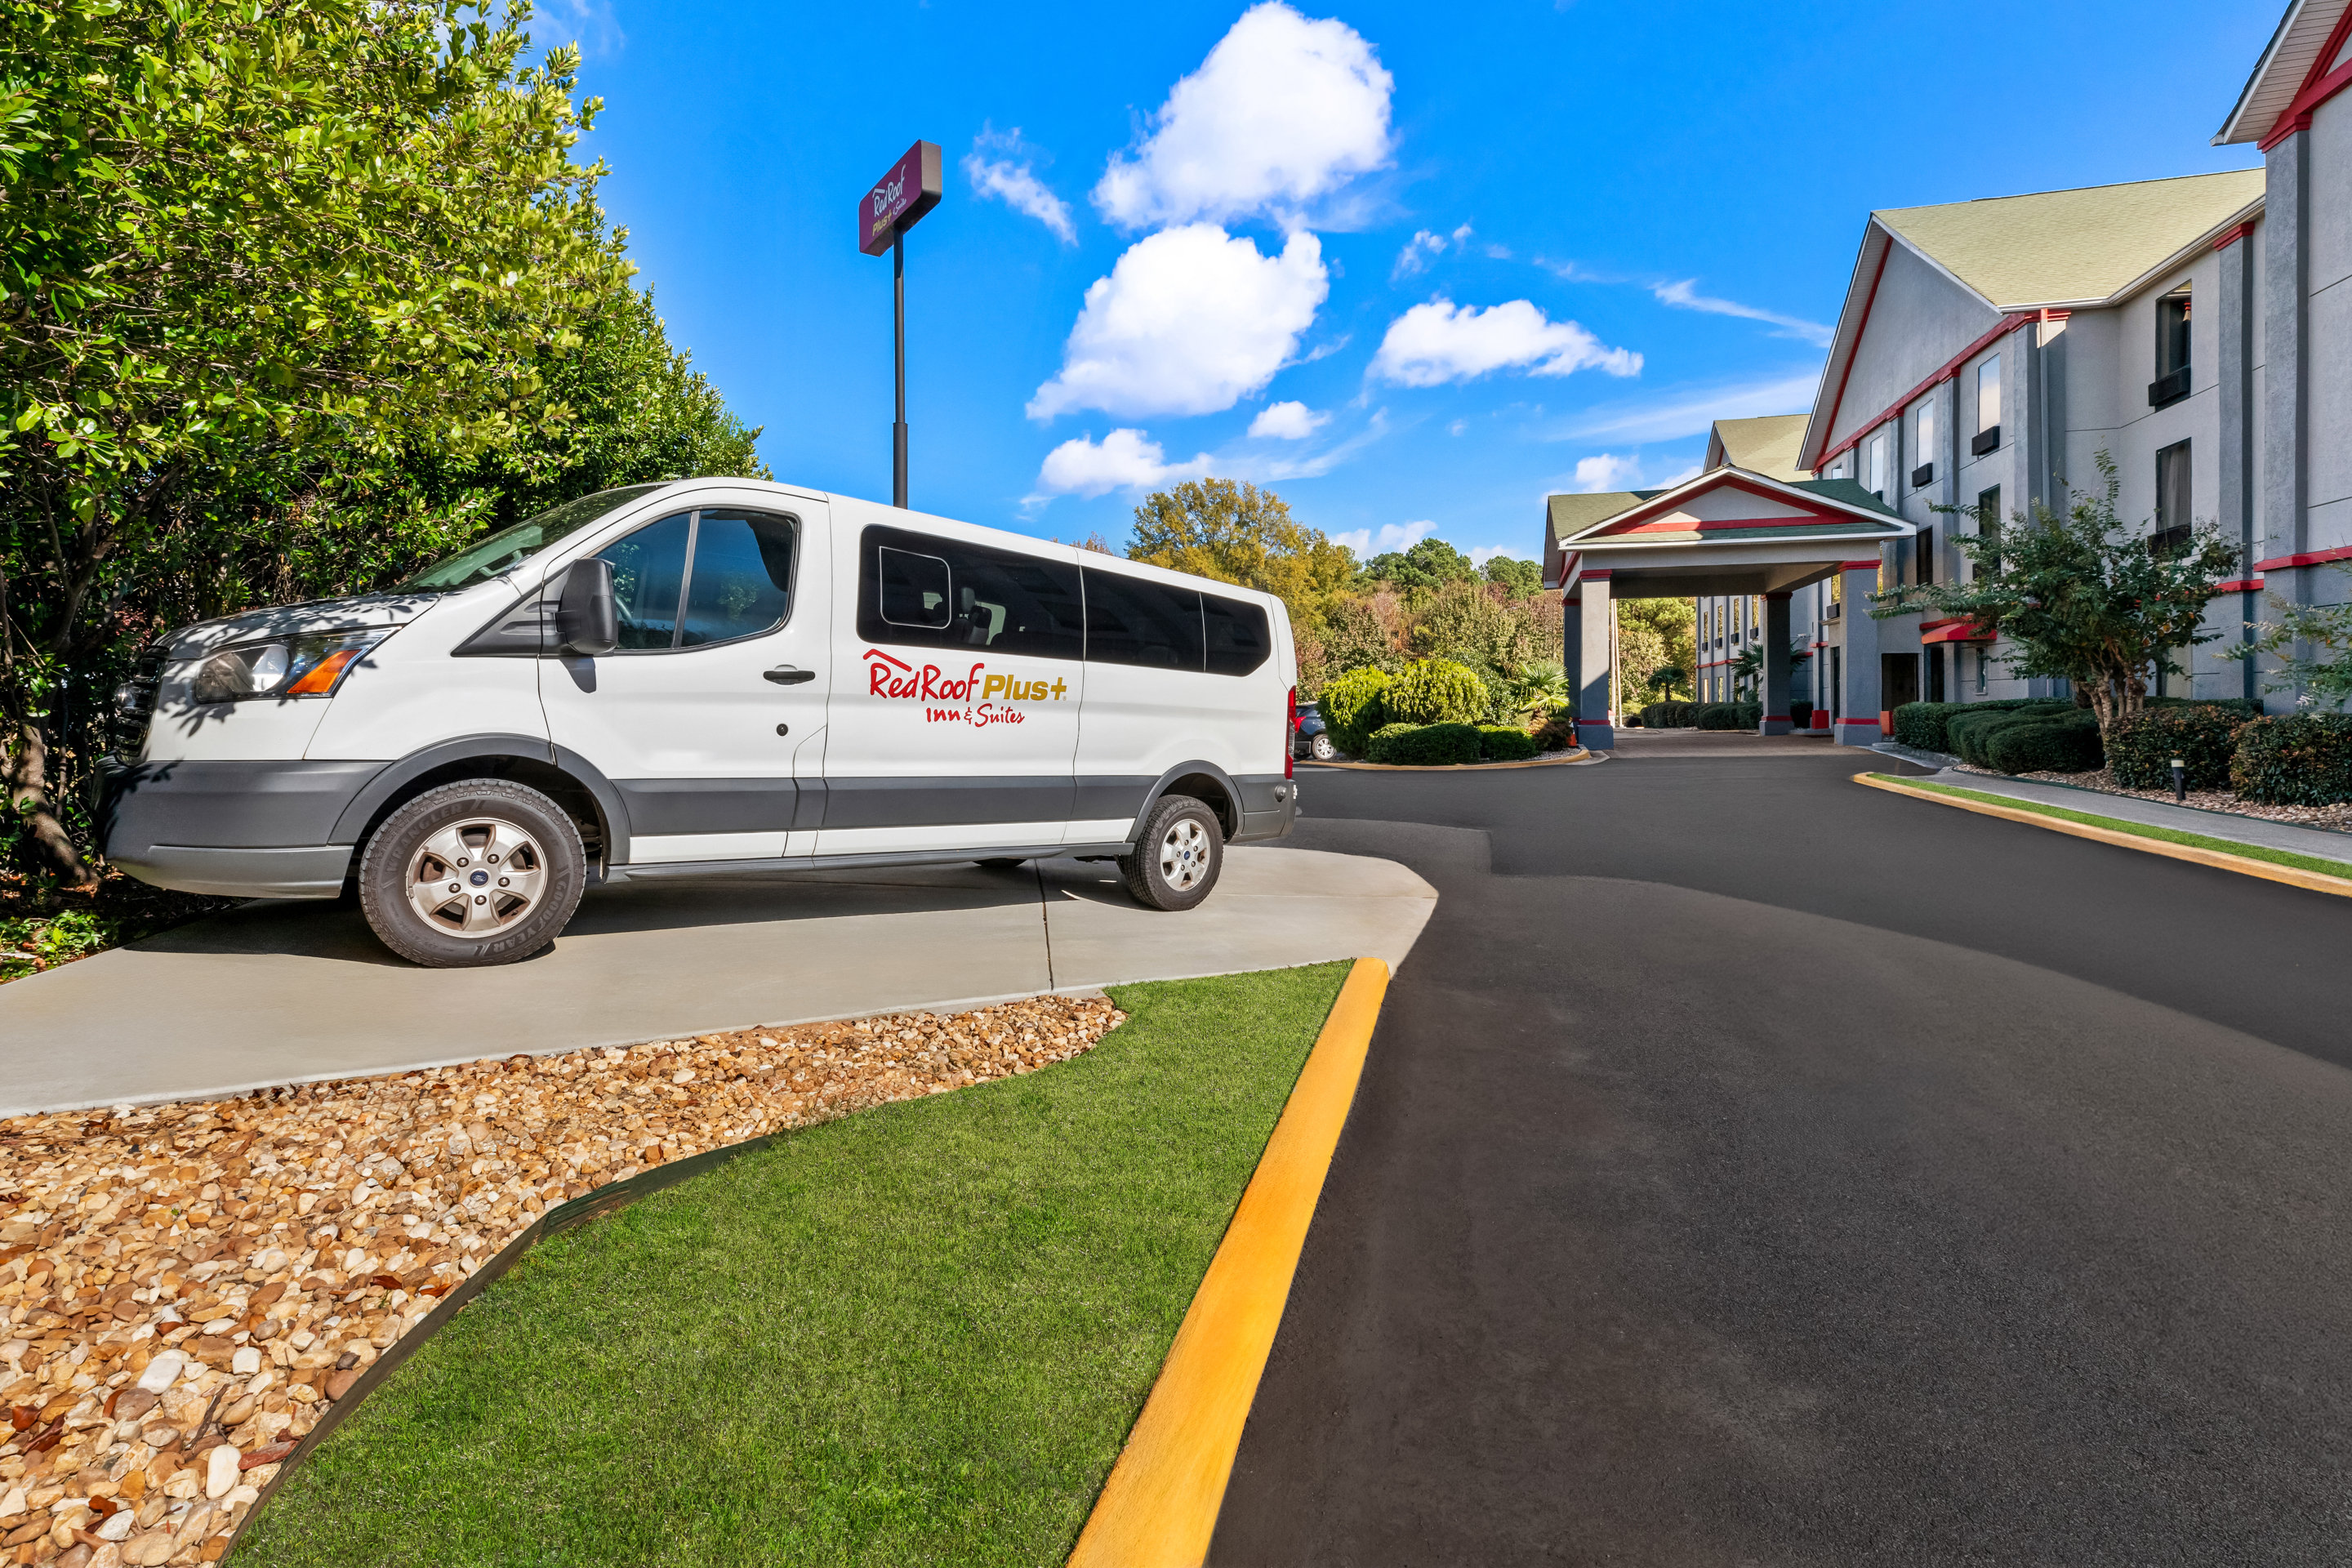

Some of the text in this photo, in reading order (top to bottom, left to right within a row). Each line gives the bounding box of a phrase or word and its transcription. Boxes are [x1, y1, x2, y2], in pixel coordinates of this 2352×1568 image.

[926, 702, 1025, 728] Inn & Suites
[385, 802, 464, 872] WRANGLER
[492, 880, 568, 953] GOODYEAR
